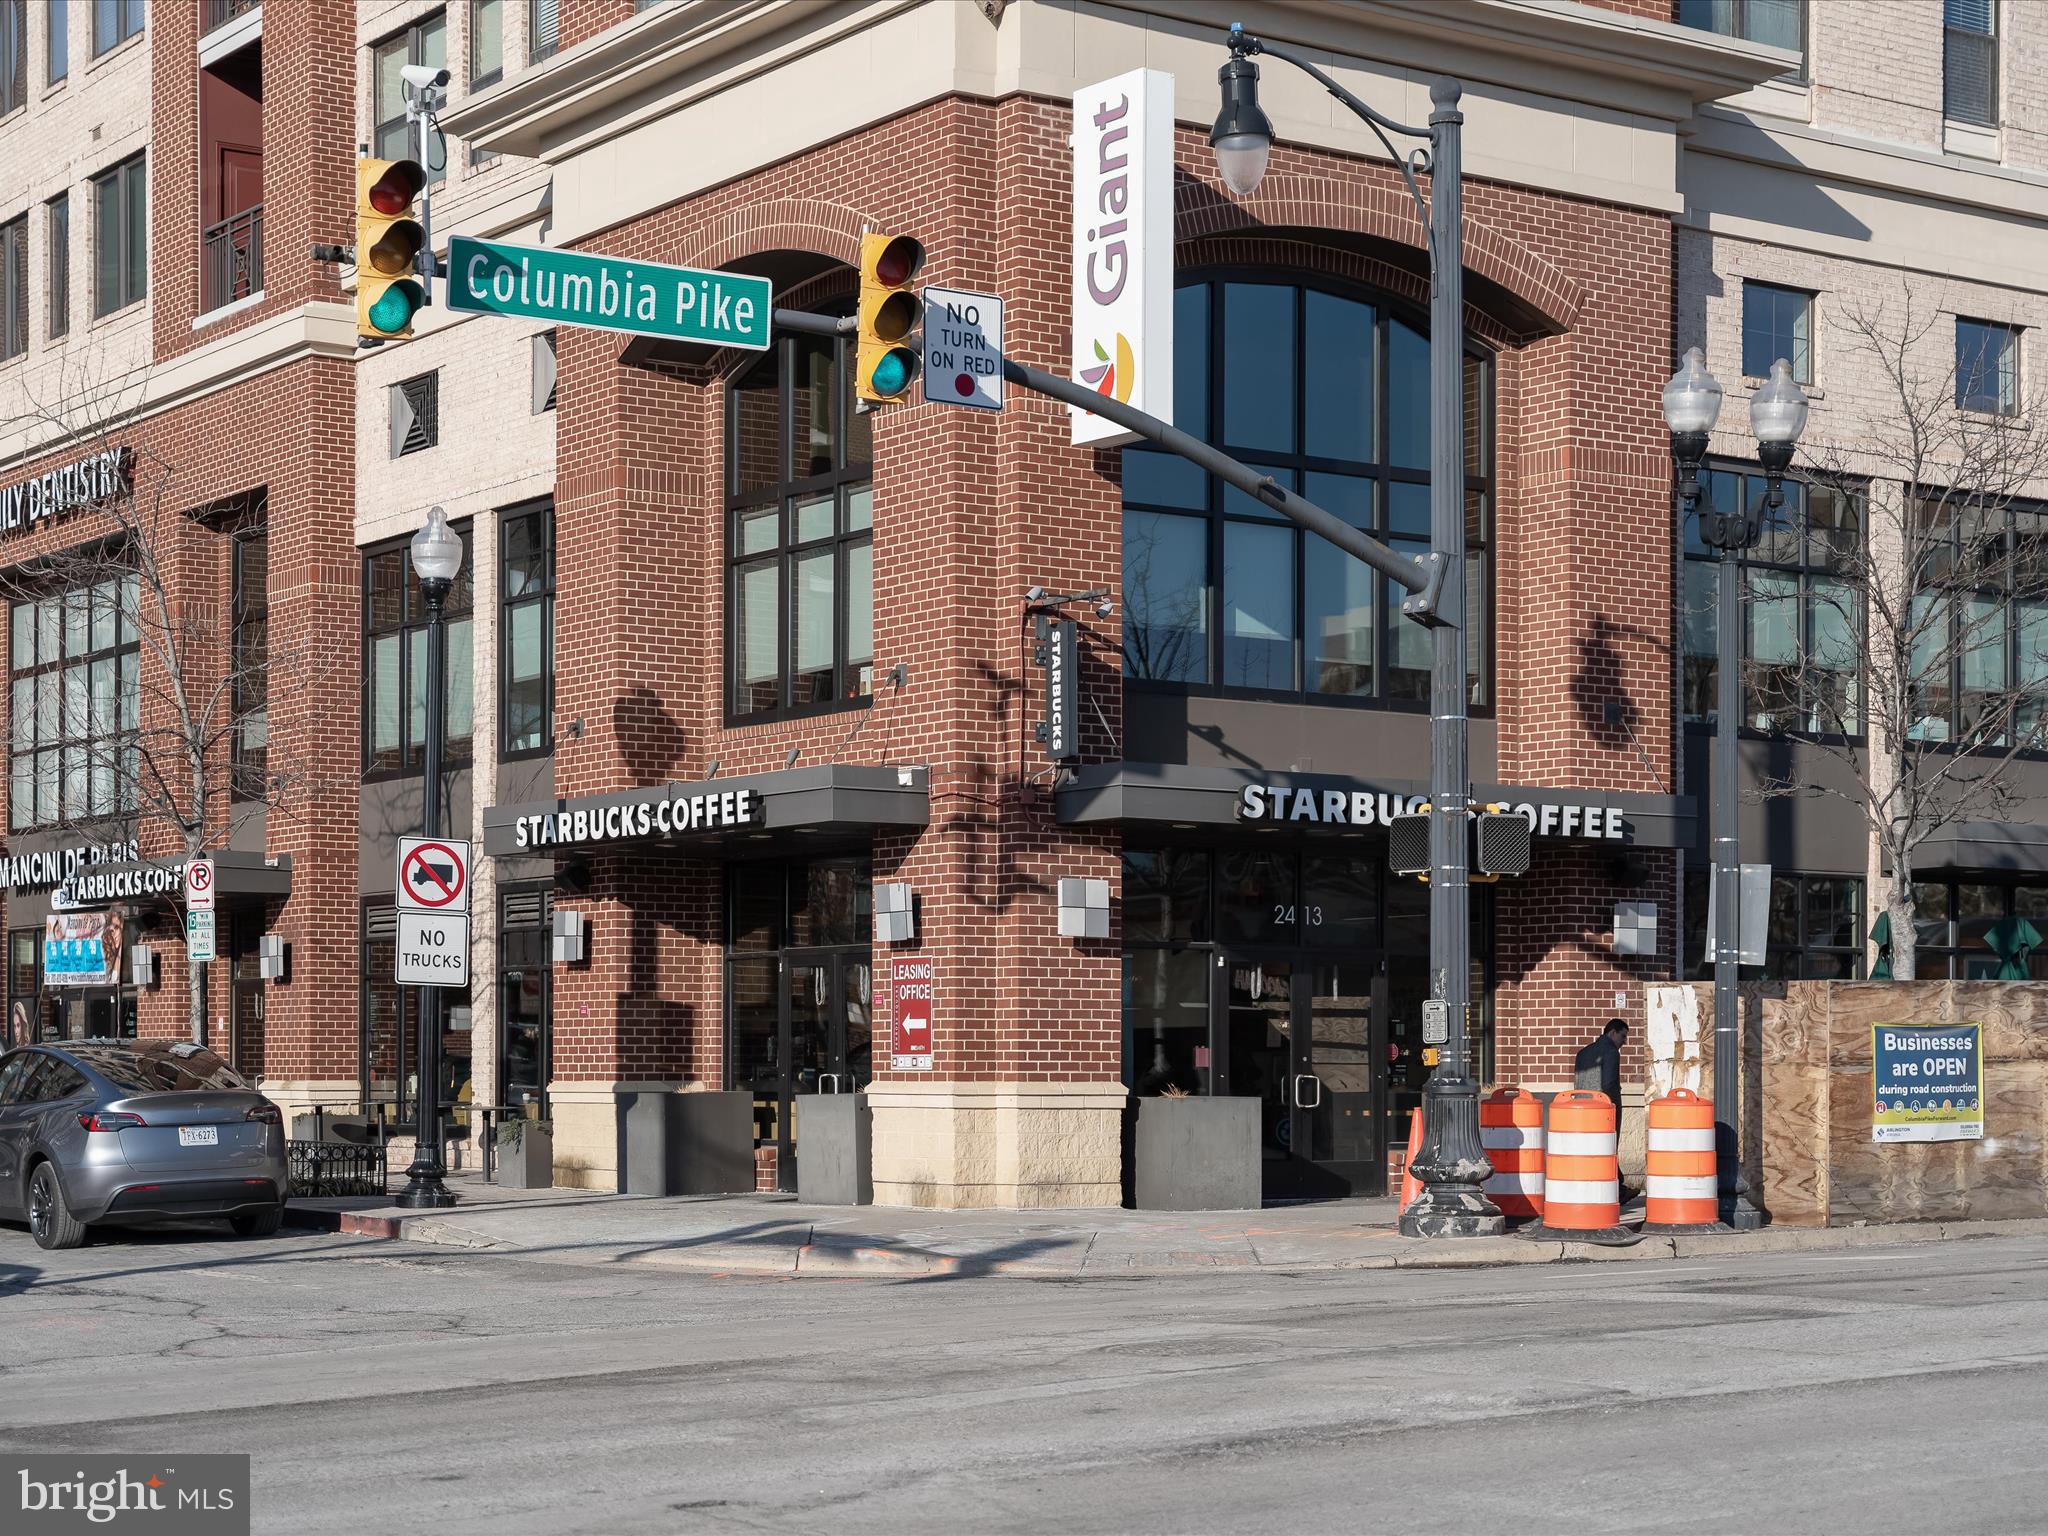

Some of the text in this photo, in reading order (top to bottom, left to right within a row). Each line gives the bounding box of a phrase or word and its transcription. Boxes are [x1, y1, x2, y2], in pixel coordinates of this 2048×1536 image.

[1087, 93, 1129, 306] Giant
[467, 253, 755, 334] Columbia Pike
[946, 302, 980, 326] NO
[941, 328, 986, 351] TURN
[931, 350, 995, 375] ON RED
[0, 446, 122, 531] ILY DENTISTRY
[1052, 631, 1062, 751] STARBUCKS
[516, 789, 750, 847] STARBUCKS COFFEE
[1494, 801, 1623, 839] OFFEE
[0, 851, 61, 888] MANCINI
[62, 870, 142, 902] STARBUCKS
[193, 942, 209, 950] TIMES
[201, 931, 211, 939] ALL
[420, 929, 445, 946] NO
[402, 952, 462, 969] TRUCKS
[893, 963, 931, 981] LEASING
[899, 983, 931, 1000] OFFICE
[1884, 1033, 1973, 1051] Businesses
[1892, 1057, 1967, 1077] are OPEN
[1878, 1083, 1977, 1096] during road construction
